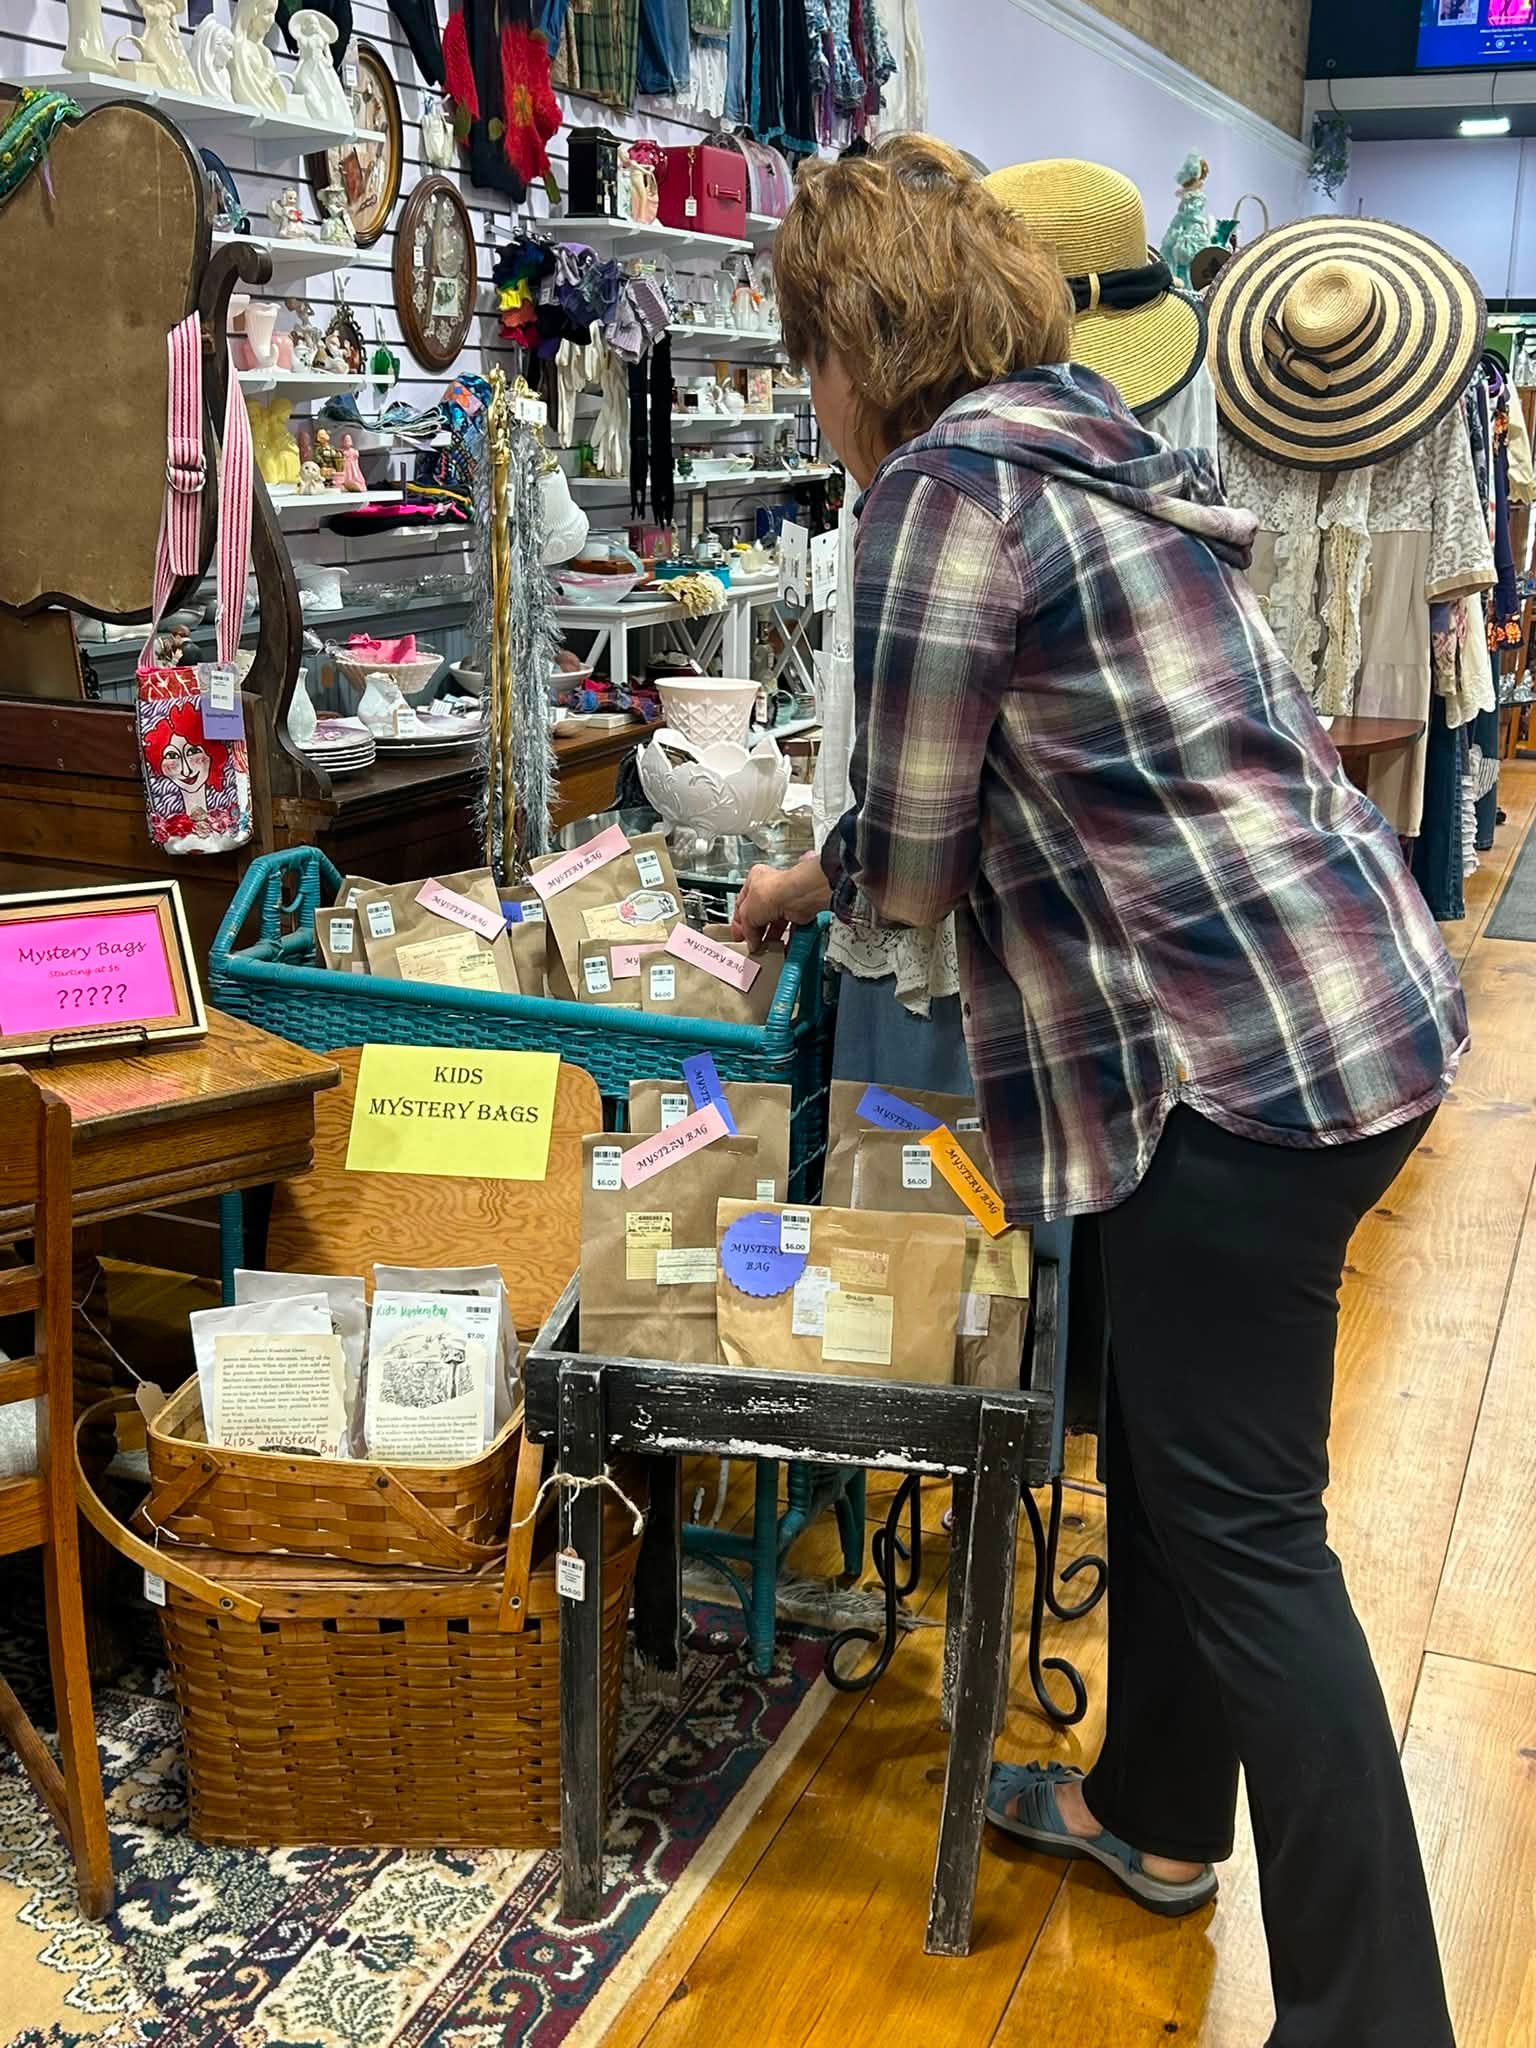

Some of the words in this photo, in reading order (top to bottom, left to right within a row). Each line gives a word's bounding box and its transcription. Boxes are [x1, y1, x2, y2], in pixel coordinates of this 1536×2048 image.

[547, 862, 584, 889] MYSTERY
[584, 850, 603, 866] BAG
[432, 895, 471, 919] MYSTERY
[469, 912, 489, 928] BAG
[18, 945, 91, 965] Mystery
[96, 941, 146, 957] Bags
[683, 937, 727, 964] MYSTERY
[726, 958, 745, 974] BAG
[48, 967, 91, 978] Starting
[94, 965, 105, 973] at
[57, 983, 127, 1009] ?????
[434, 1066, 484, 1085] KIDS
[369, 1097, 475, 1120] MYSTERY
[477, 1104, 539, 1123] BAGS
[636, 1137, 685, 1170] MYSTERY
[684, 1124, 709, 1142] BAG
[945, 1147, 984, 1194] MYSTERY
[979, 1190, 1001, 1215] BAG
[785, 1242, 806, 1250] $6.00
[745, 1261, 771, 1272] BAG
